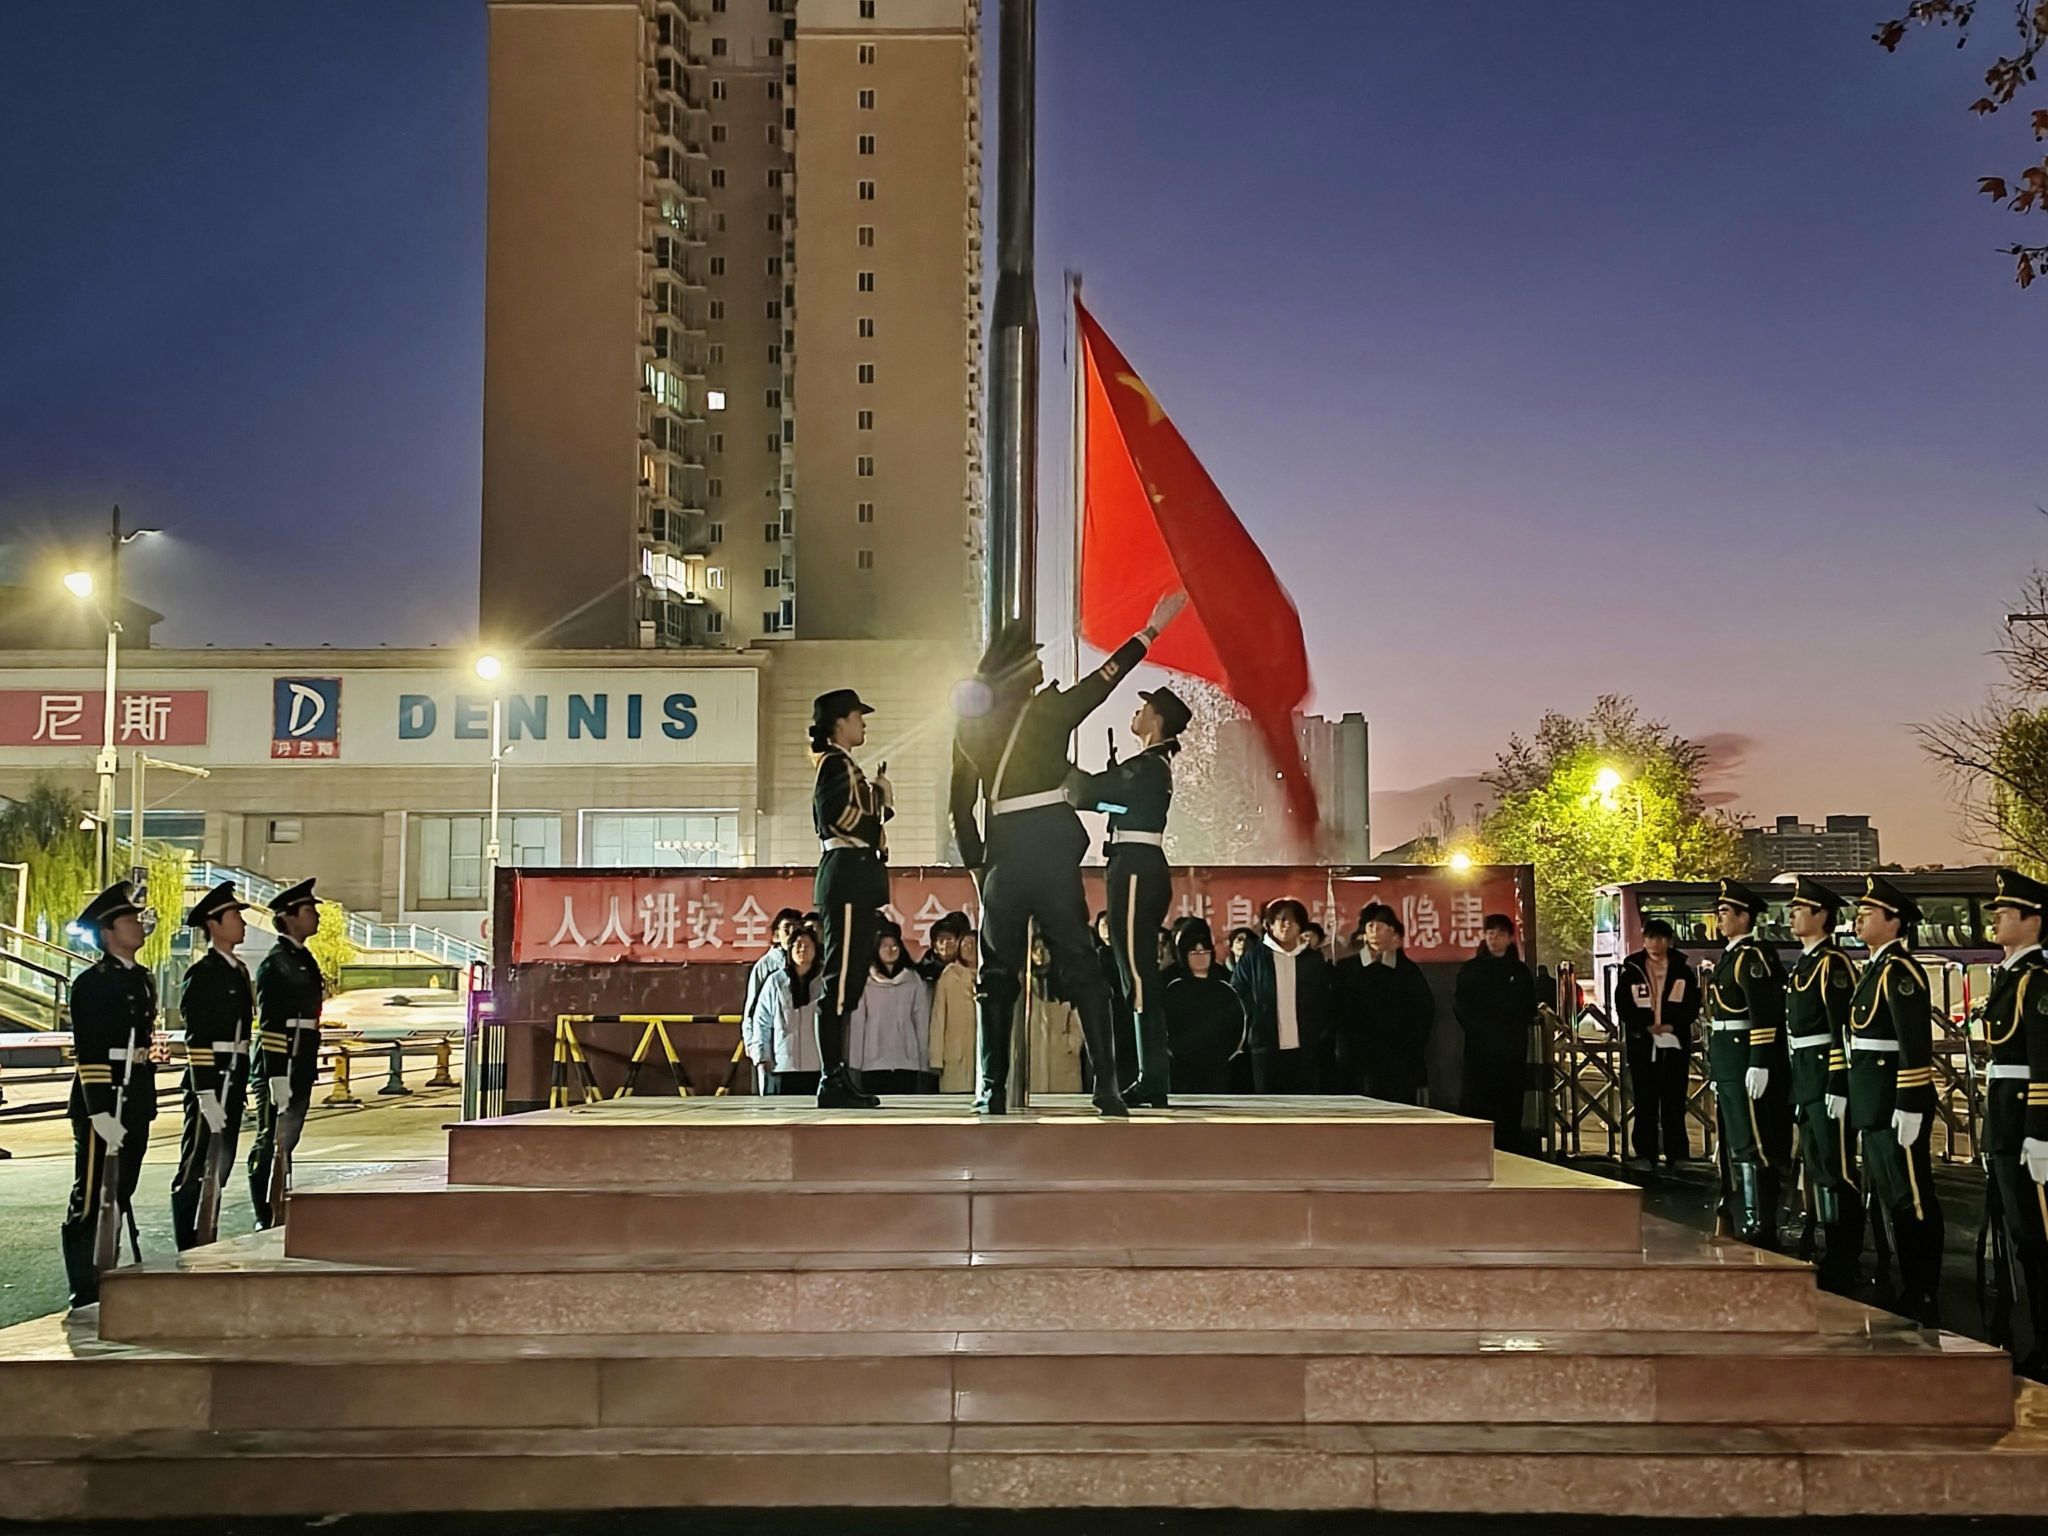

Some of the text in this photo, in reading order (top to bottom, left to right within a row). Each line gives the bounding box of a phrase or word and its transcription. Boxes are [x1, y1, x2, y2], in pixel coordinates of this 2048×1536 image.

[33, 695, 172, 741] 尼斯
[398, 693, 698, 740] DENNIS
[549, 892, 770, 949] 人人讲安全
